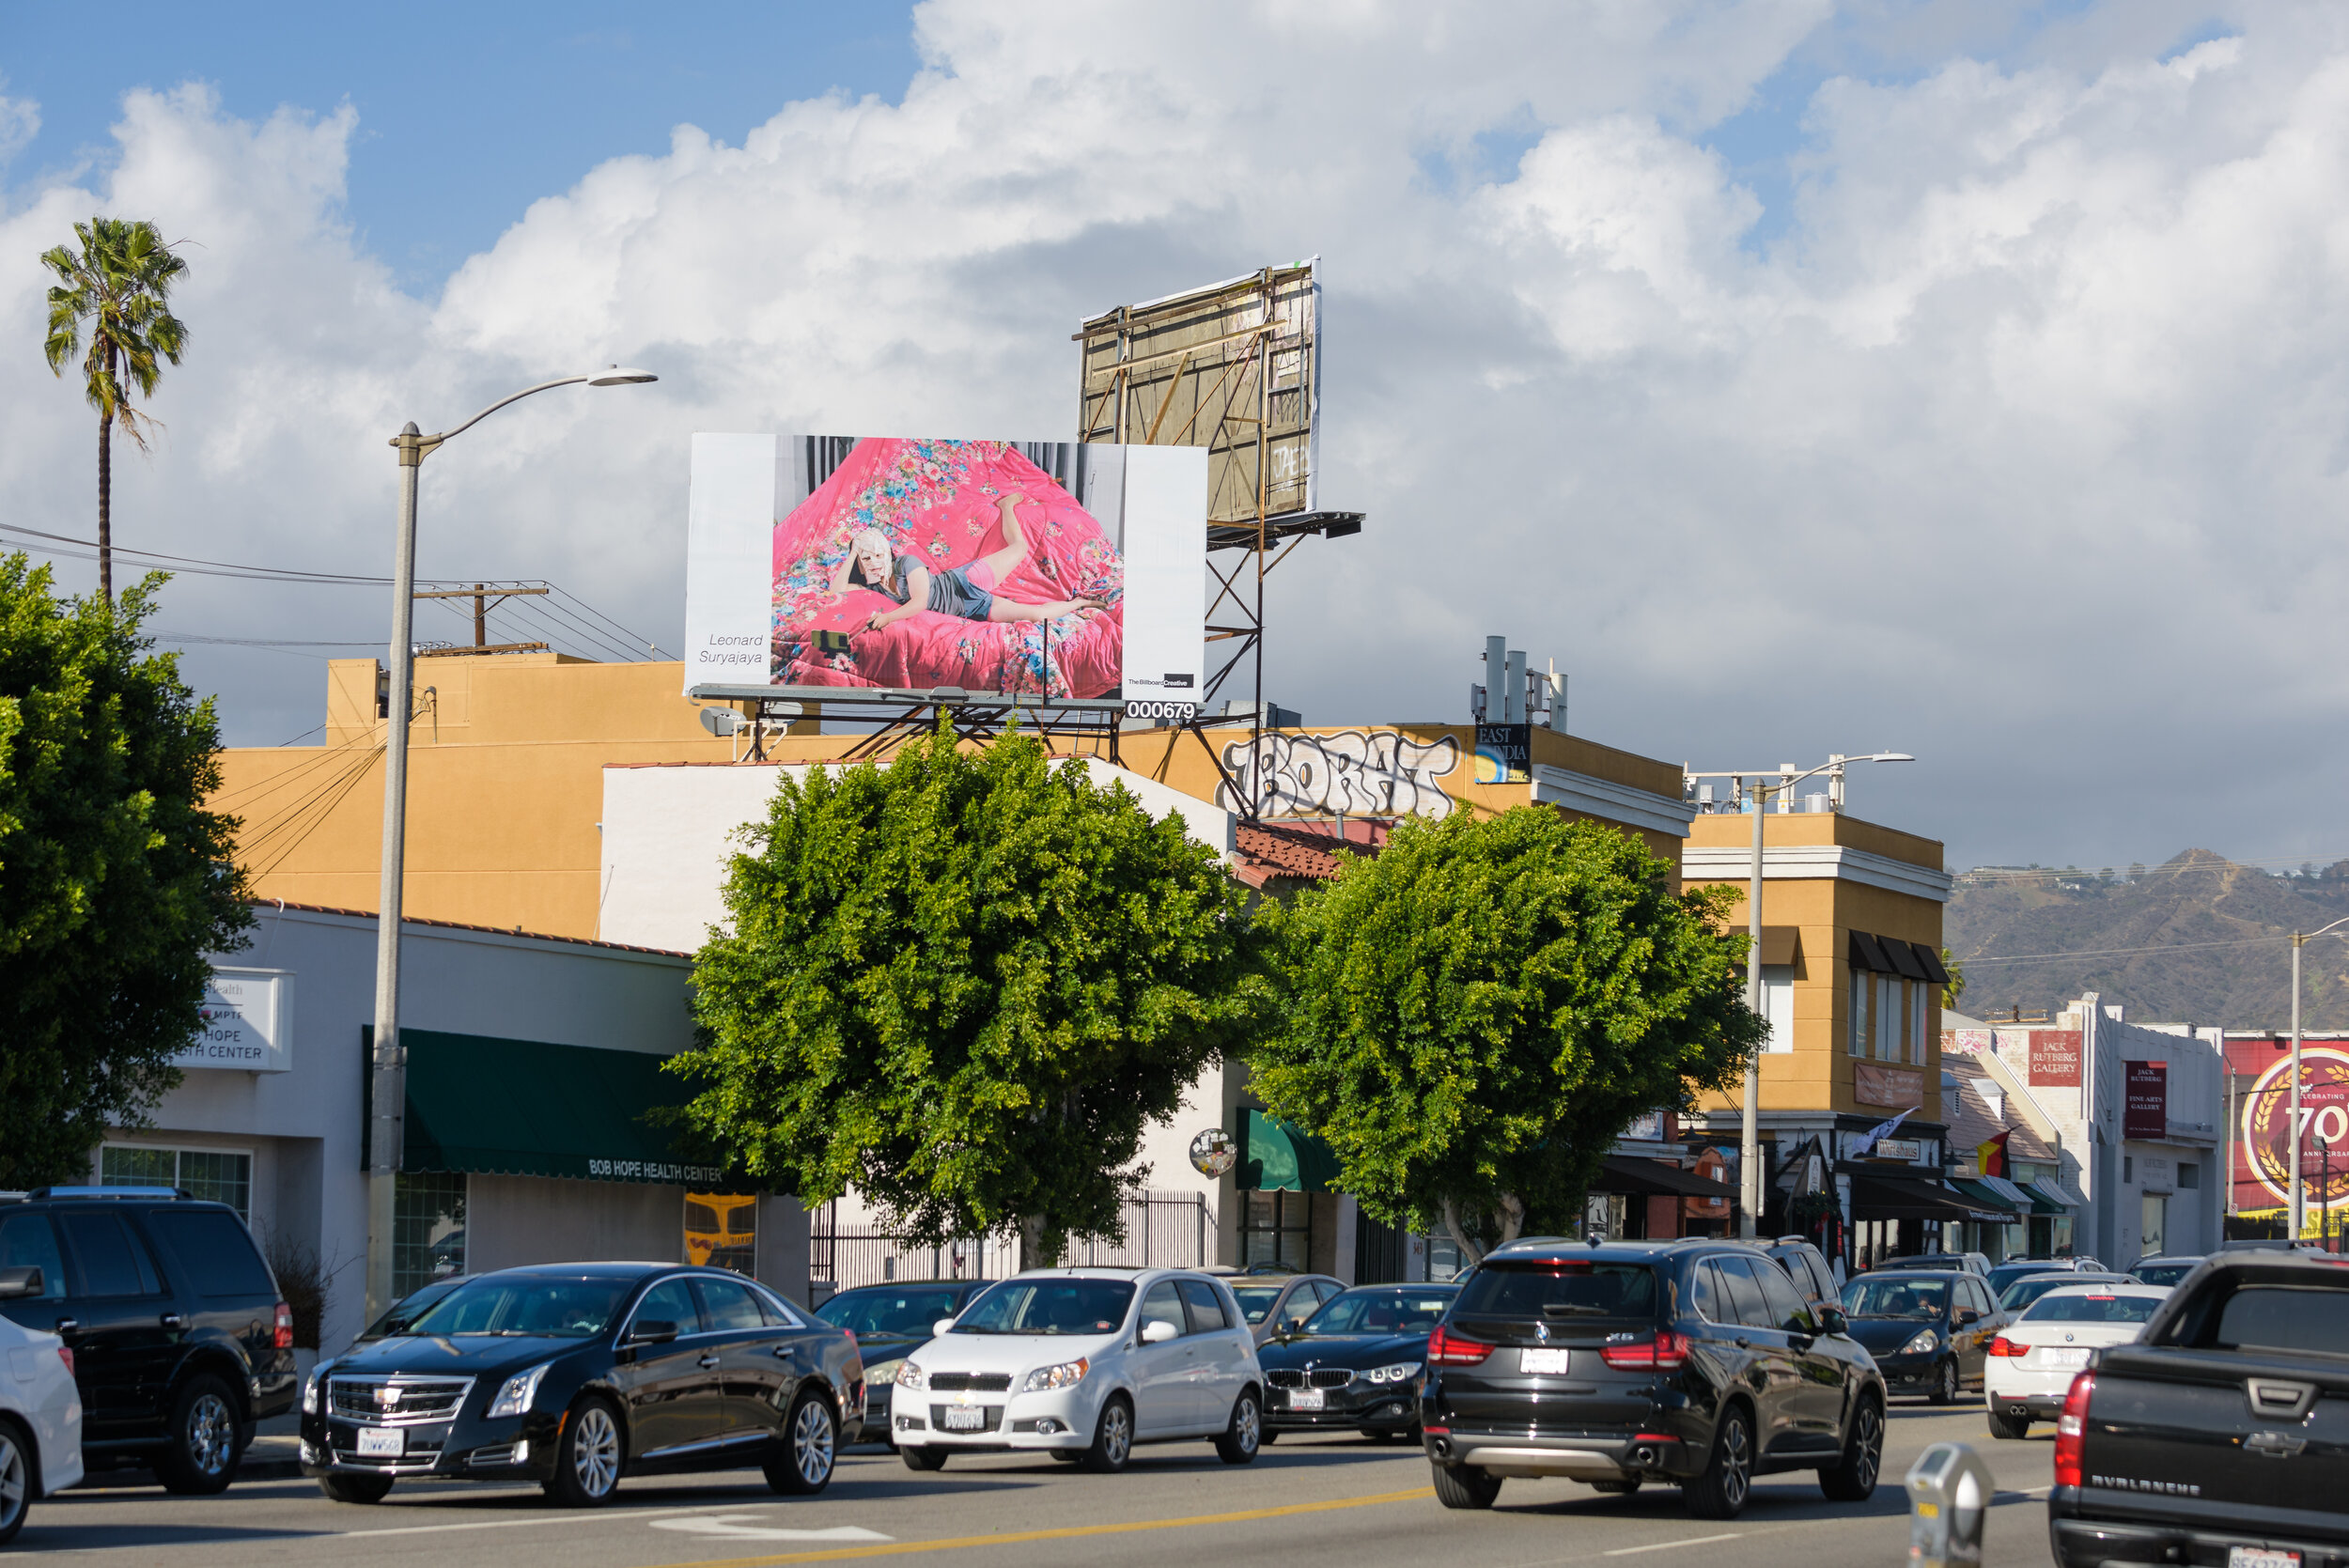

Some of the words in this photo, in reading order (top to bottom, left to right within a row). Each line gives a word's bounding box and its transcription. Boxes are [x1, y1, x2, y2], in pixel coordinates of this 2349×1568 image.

[709, 633, 764, 646] Leonard
[699, 650, 763, 665] Suryajaya
[1128, 701, 1195, 720] 000679
[1479, 727, 1512, 743] EAST
[205, 1030, 241, 1043] HOPE
[209, 1046, 262, 1059] CENTER
[2043, 1042, 2067, 1051] JACK
[2032, 1052, 2077, 1063] RUTBERG
[2032, 1063, 2077, 1074] GALLERY
[1878, 1141, 1919, 1158] Wirtshaus
[589, 1159, 612, 1175] BOB
[613, 1159, 642, 1177] HOPE
[644, 1162, 682, 1181] HEALTH
[683, 1165, 723, 1183] CENTER
[2092, 1474, 2201, 1497] AVALANCHE
